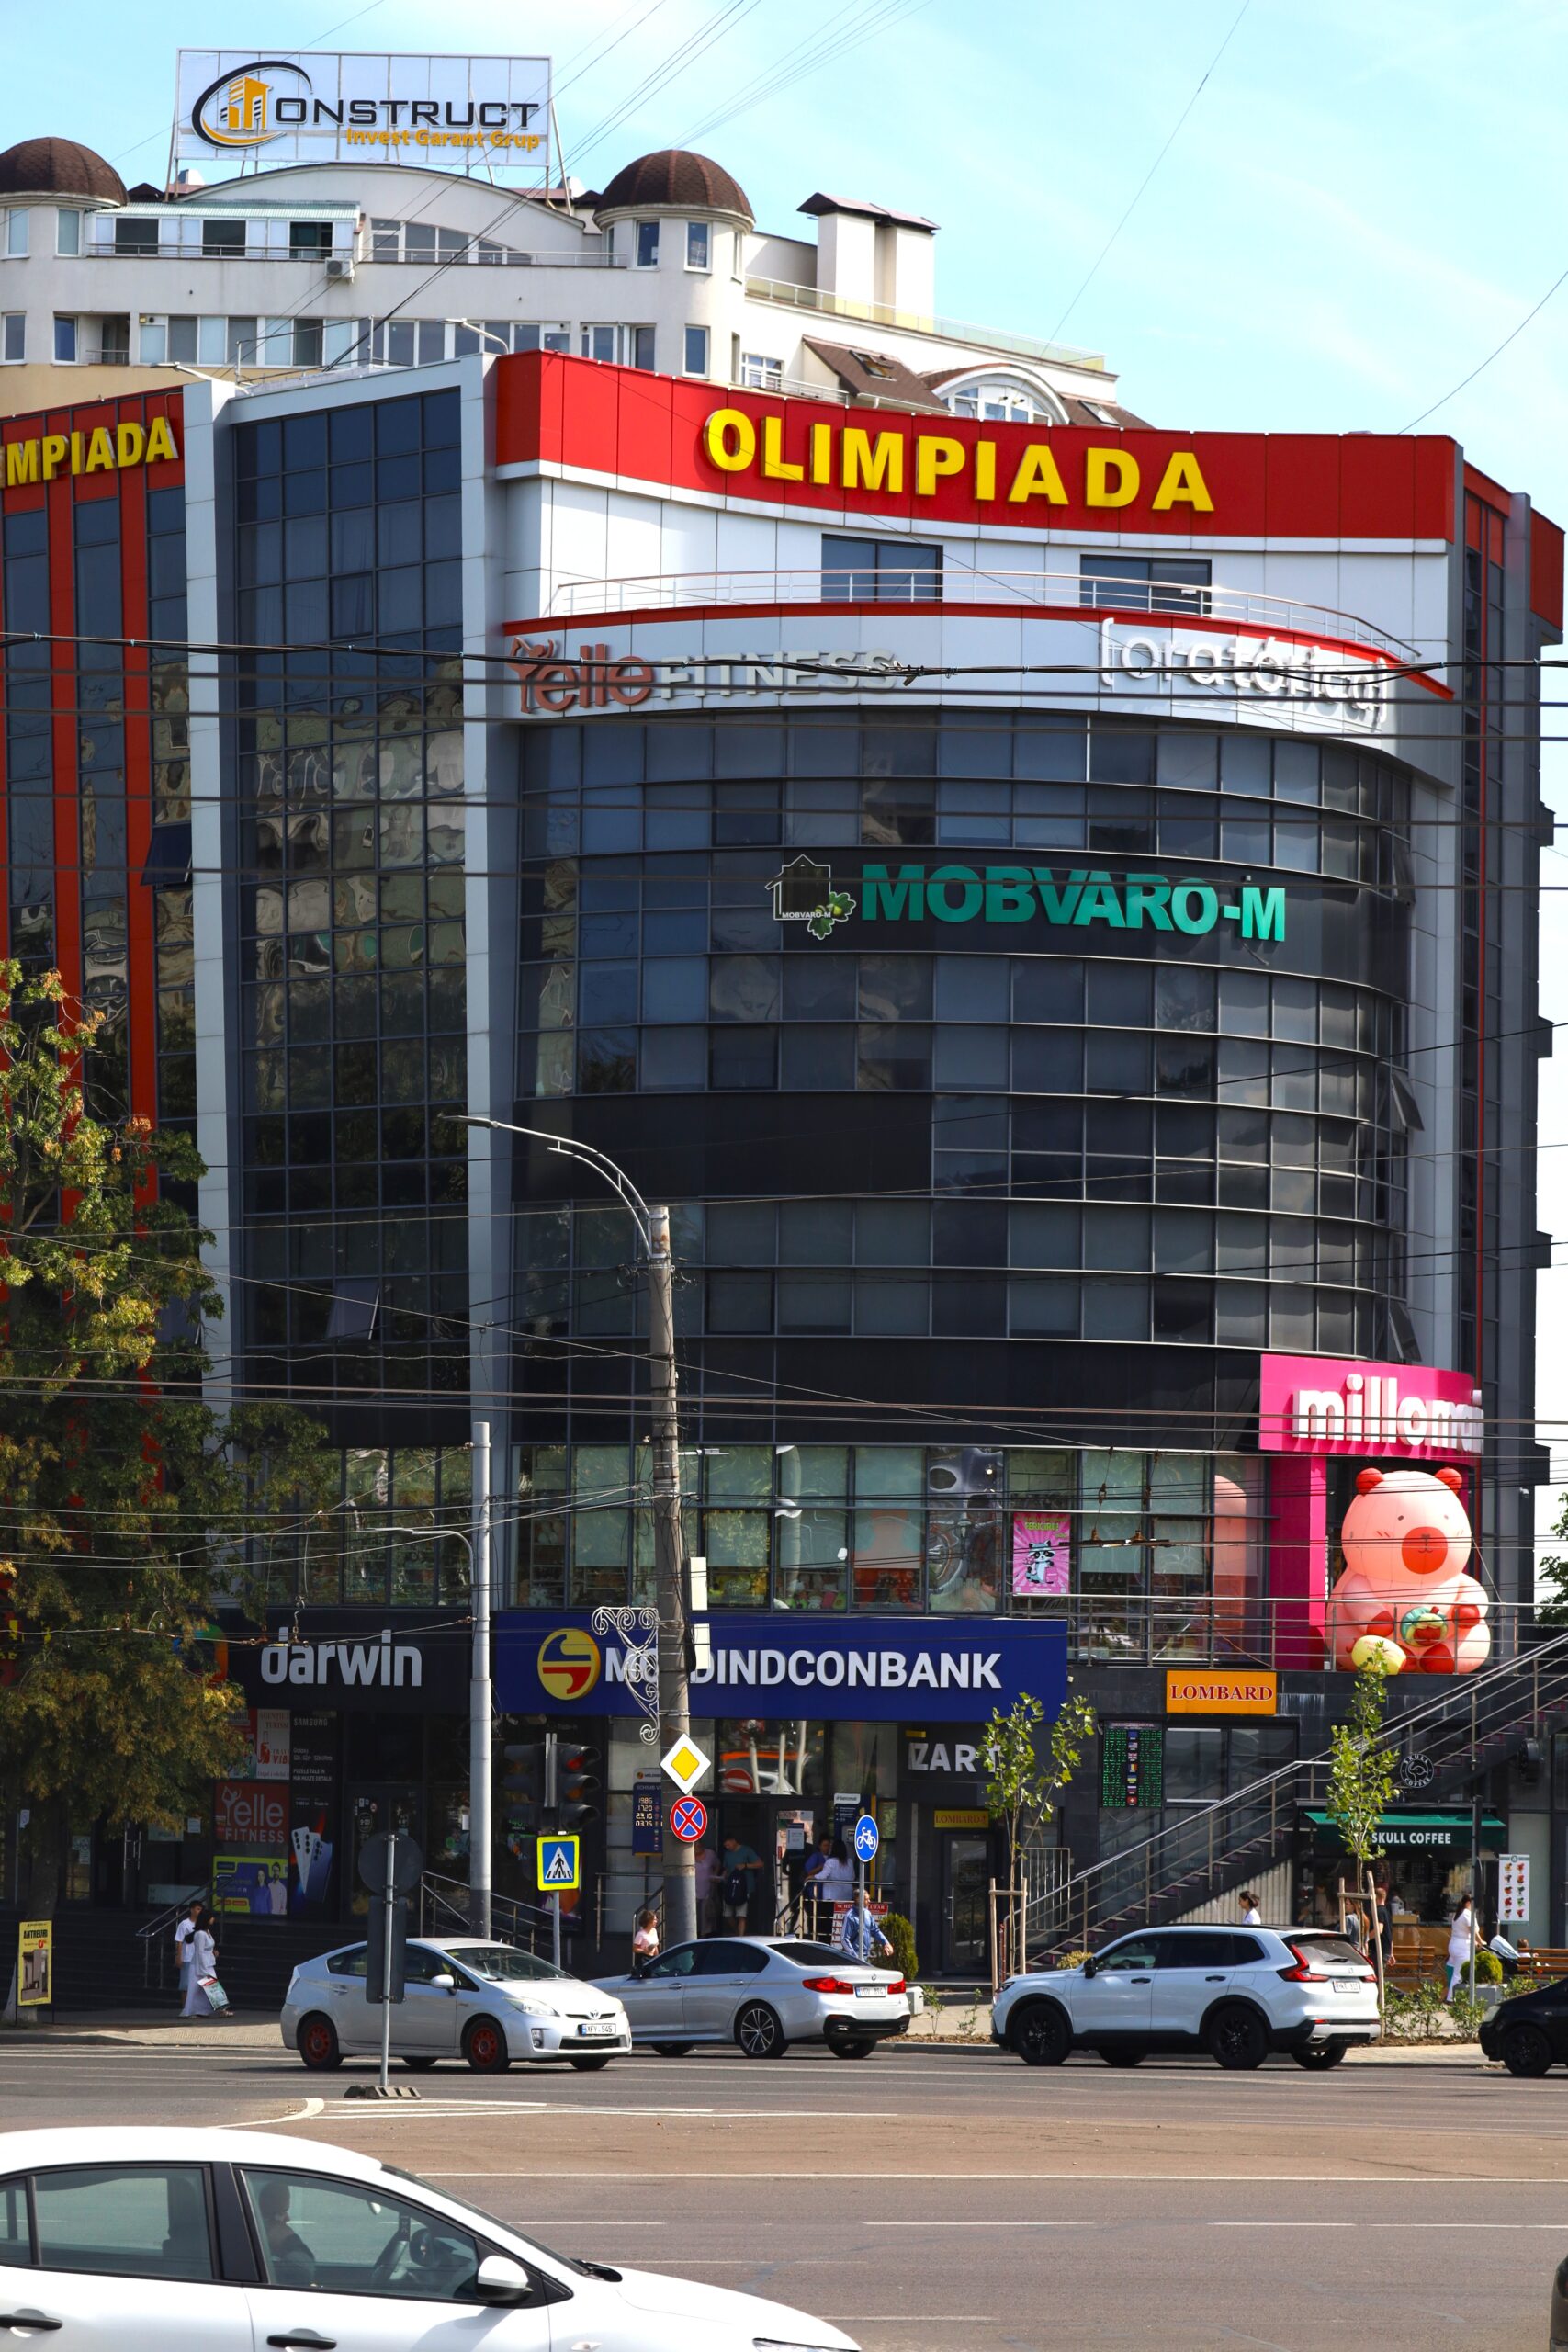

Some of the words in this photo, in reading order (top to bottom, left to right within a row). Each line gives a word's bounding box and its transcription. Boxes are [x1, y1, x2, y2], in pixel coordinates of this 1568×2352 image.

[346, 128, 410, 146] Invest
[415, 130, 484, 148] Garant
[490, 131, 540, 153] Grup
[0, 416, 176, 490] MPIADA
[704, 409, 1214, 513] OLIMPIADA
[660, 649, 897, 700] FITNESS
[862, 864, 1285, 942] MOBVARO-M
[260, 1626, 422, 1687] darwin
[604, 1647, 1002, 1689] MODINDCONBANK
[1170, 1684, 1273, 1702] LOMBARD
[293, 1717, 328, 1727] SAMSUNG
[1404, 1754, 1430, 1765] SKULL
[1404, 1777, 1431, 1788] COFFEE
[225, 1828, 285, 1843] FITNESS
[1371, 1832, 1406, 1844] SKULL
[1409, 1832, 1451, 1845] COFFEE
